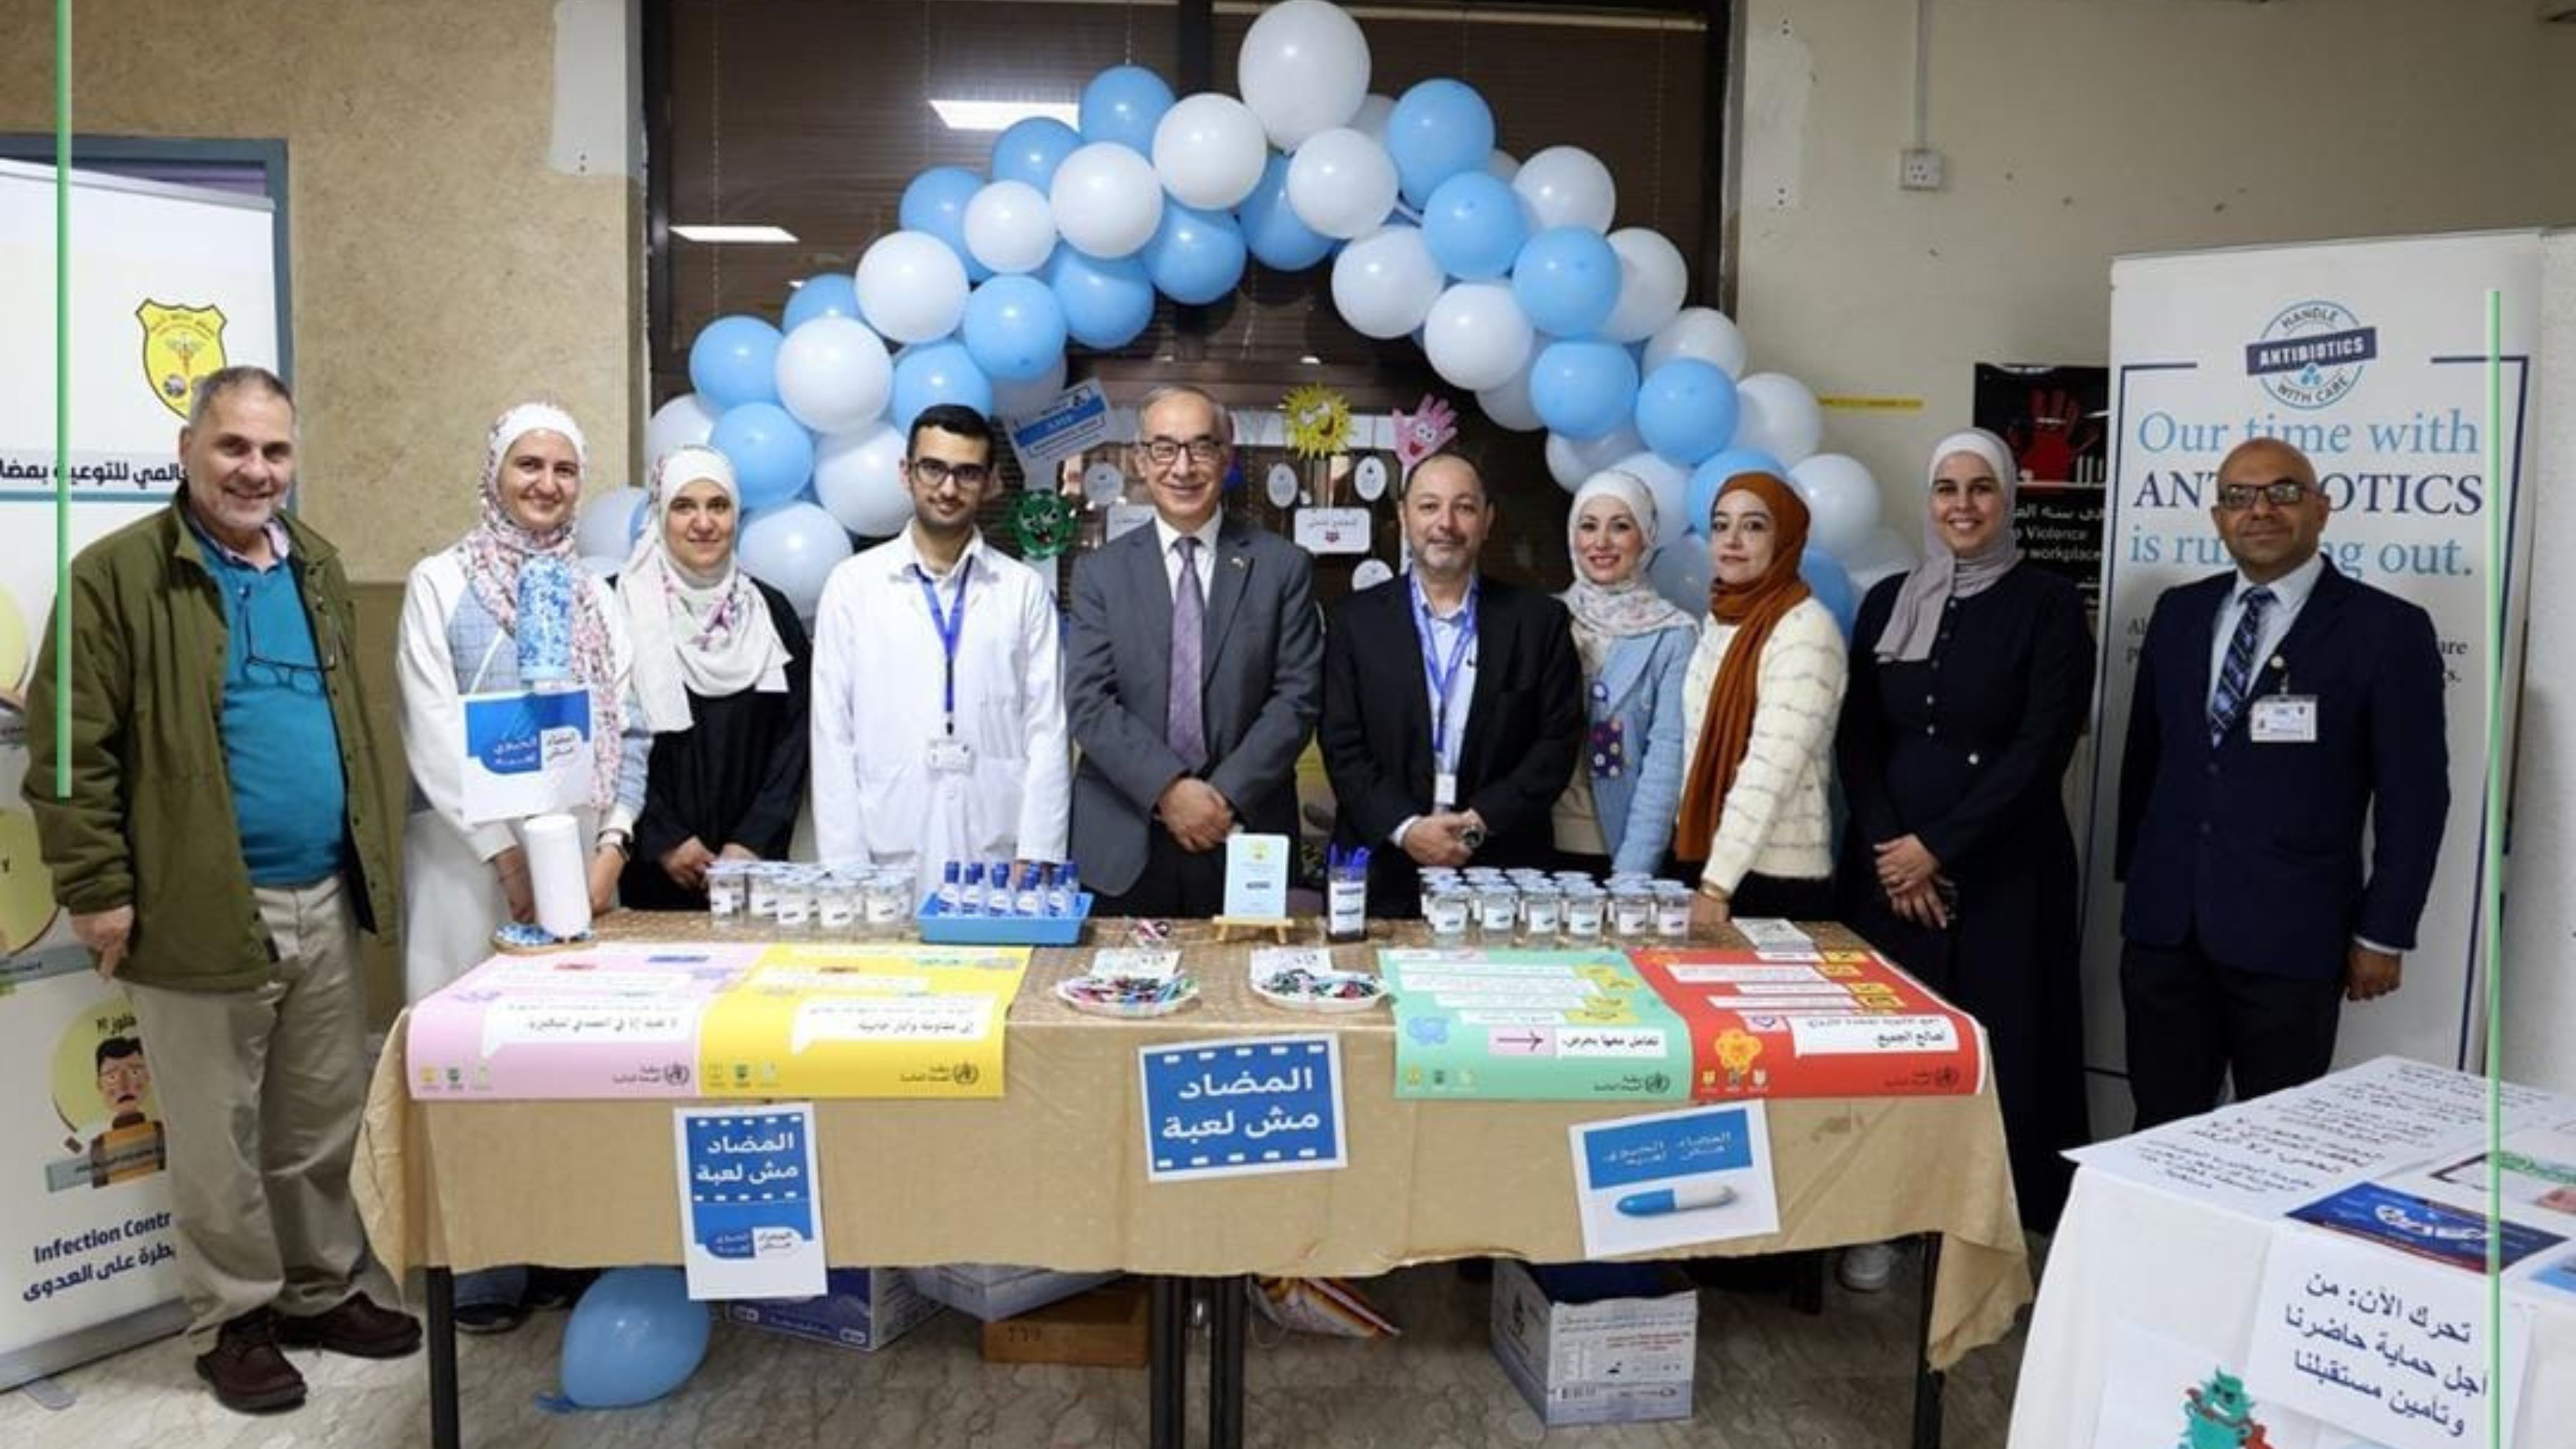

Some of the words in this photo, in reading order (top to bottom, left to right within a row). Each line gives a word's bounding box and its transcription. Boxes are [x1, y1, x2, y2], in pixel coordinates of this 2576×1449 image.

[2281, 307, 2338, 328] HANDLE
[2260, 336, 2364, 367] ANTIBIOTICS
[2278, 383, 2312, 403] WITH
[2316, 376, 2348, 402] CARE
[2138, 411, 2228, 454] Our
[2244, 413, 2352, 452] time
[2370, 408, 2478, 454] with
[2133, 470, 2482, 516] ANOTICS
[2026, 524, 2089, 541] Violence
[2029, 545, 2102, 563] workplace
[2130, 525, 2160, 564] is
[2174, 533, 2365, 577] rung
[2379, 539, 2473, 576] out.
[1178, 1067, 1314, 1099] المضاد
[1162, 1109, 1235, 1145] لعبة
[1244, 1105, 1320, 1139] مش
[707, 1130, 795, 1155] المضاد
[696, 1162, 743, 1187] لعبة
[747, 1159, 799, 1185] مش
[33, 1226, 121, 1264] Infection
[123, 1212, 172, 1238] Contr
[23, 1263, 94, 1302] العدوى
[96, 1255, 136, 1281] على
[2305, 1273, 2339, 1296] من
[2285, 1302, 2368, 1350] حاضرنا
[2408, 1306, 2471, 1343] تحرك
[2374, 1331, 2436, 1378] حماية
[2294, 1348, 2383, 1399] مستقبلنا
